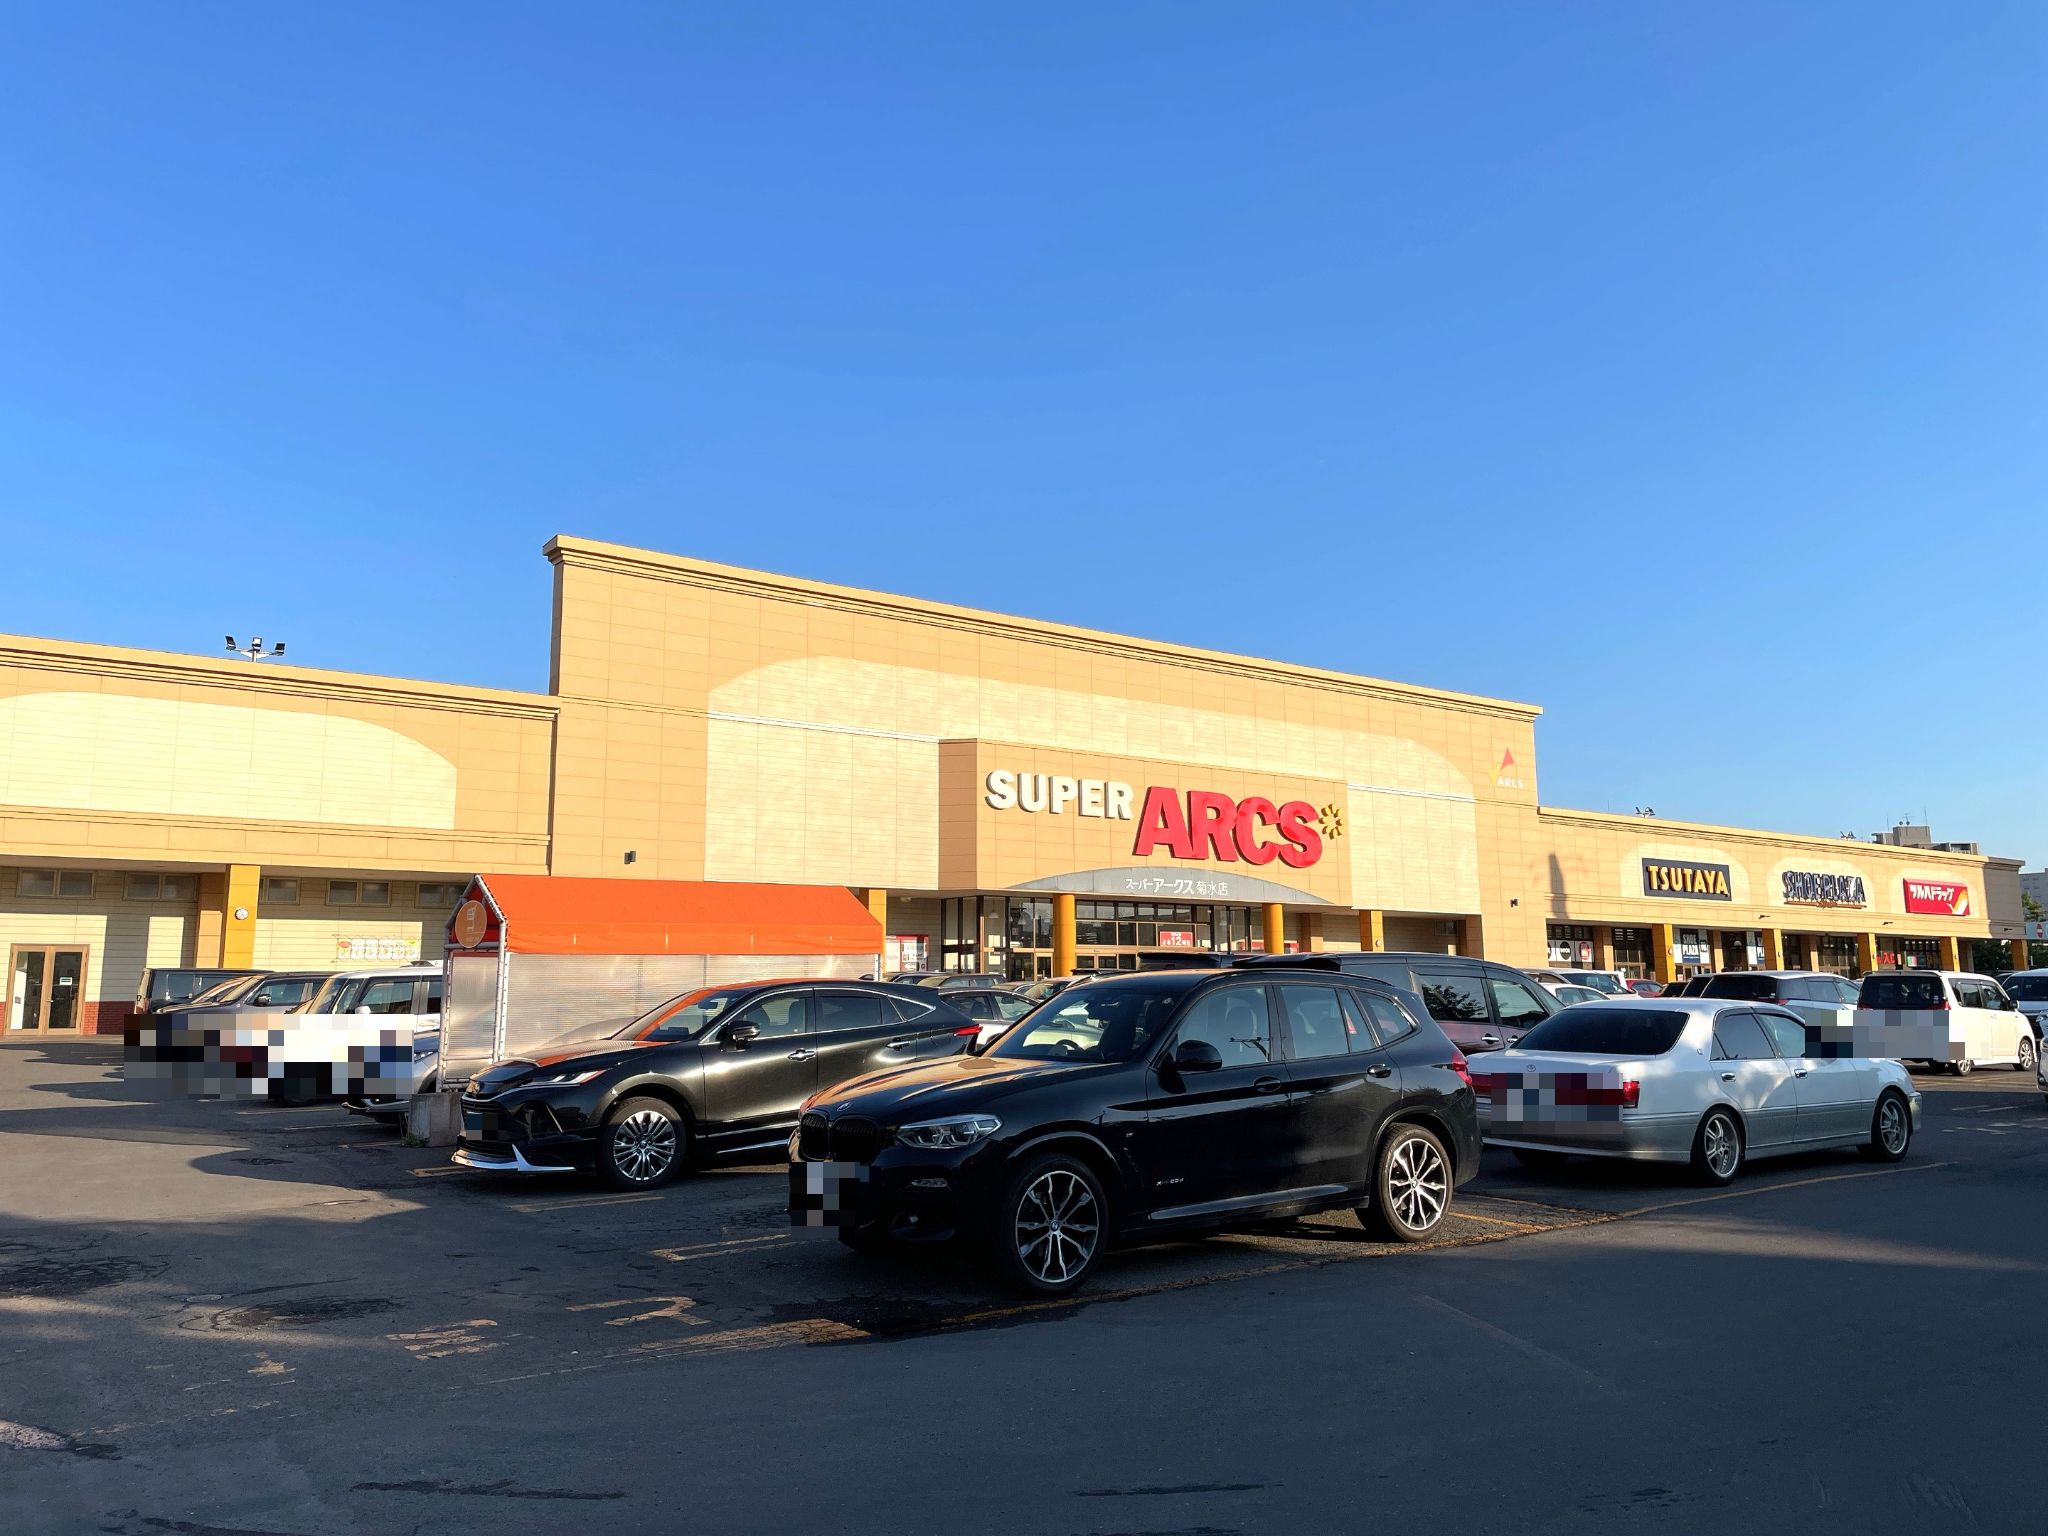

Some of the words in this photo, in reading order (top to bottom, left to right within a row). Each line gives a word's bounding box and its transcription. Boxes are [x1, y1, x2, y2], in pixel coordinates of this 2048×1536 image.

[1497, 777, 1524, 789] ARCS
[985, 769, 1134, 820] SUPER
[1132, 786, 1323, 868] ARCS
[1125, 878, 1195, 895] スーパーアークス
[1196, 880, 1229, 896] 菊水店
[1647, 865, 1728, 896] TSUTAYA
[1909, 884, 1955, 902] ツルハドラッグ
